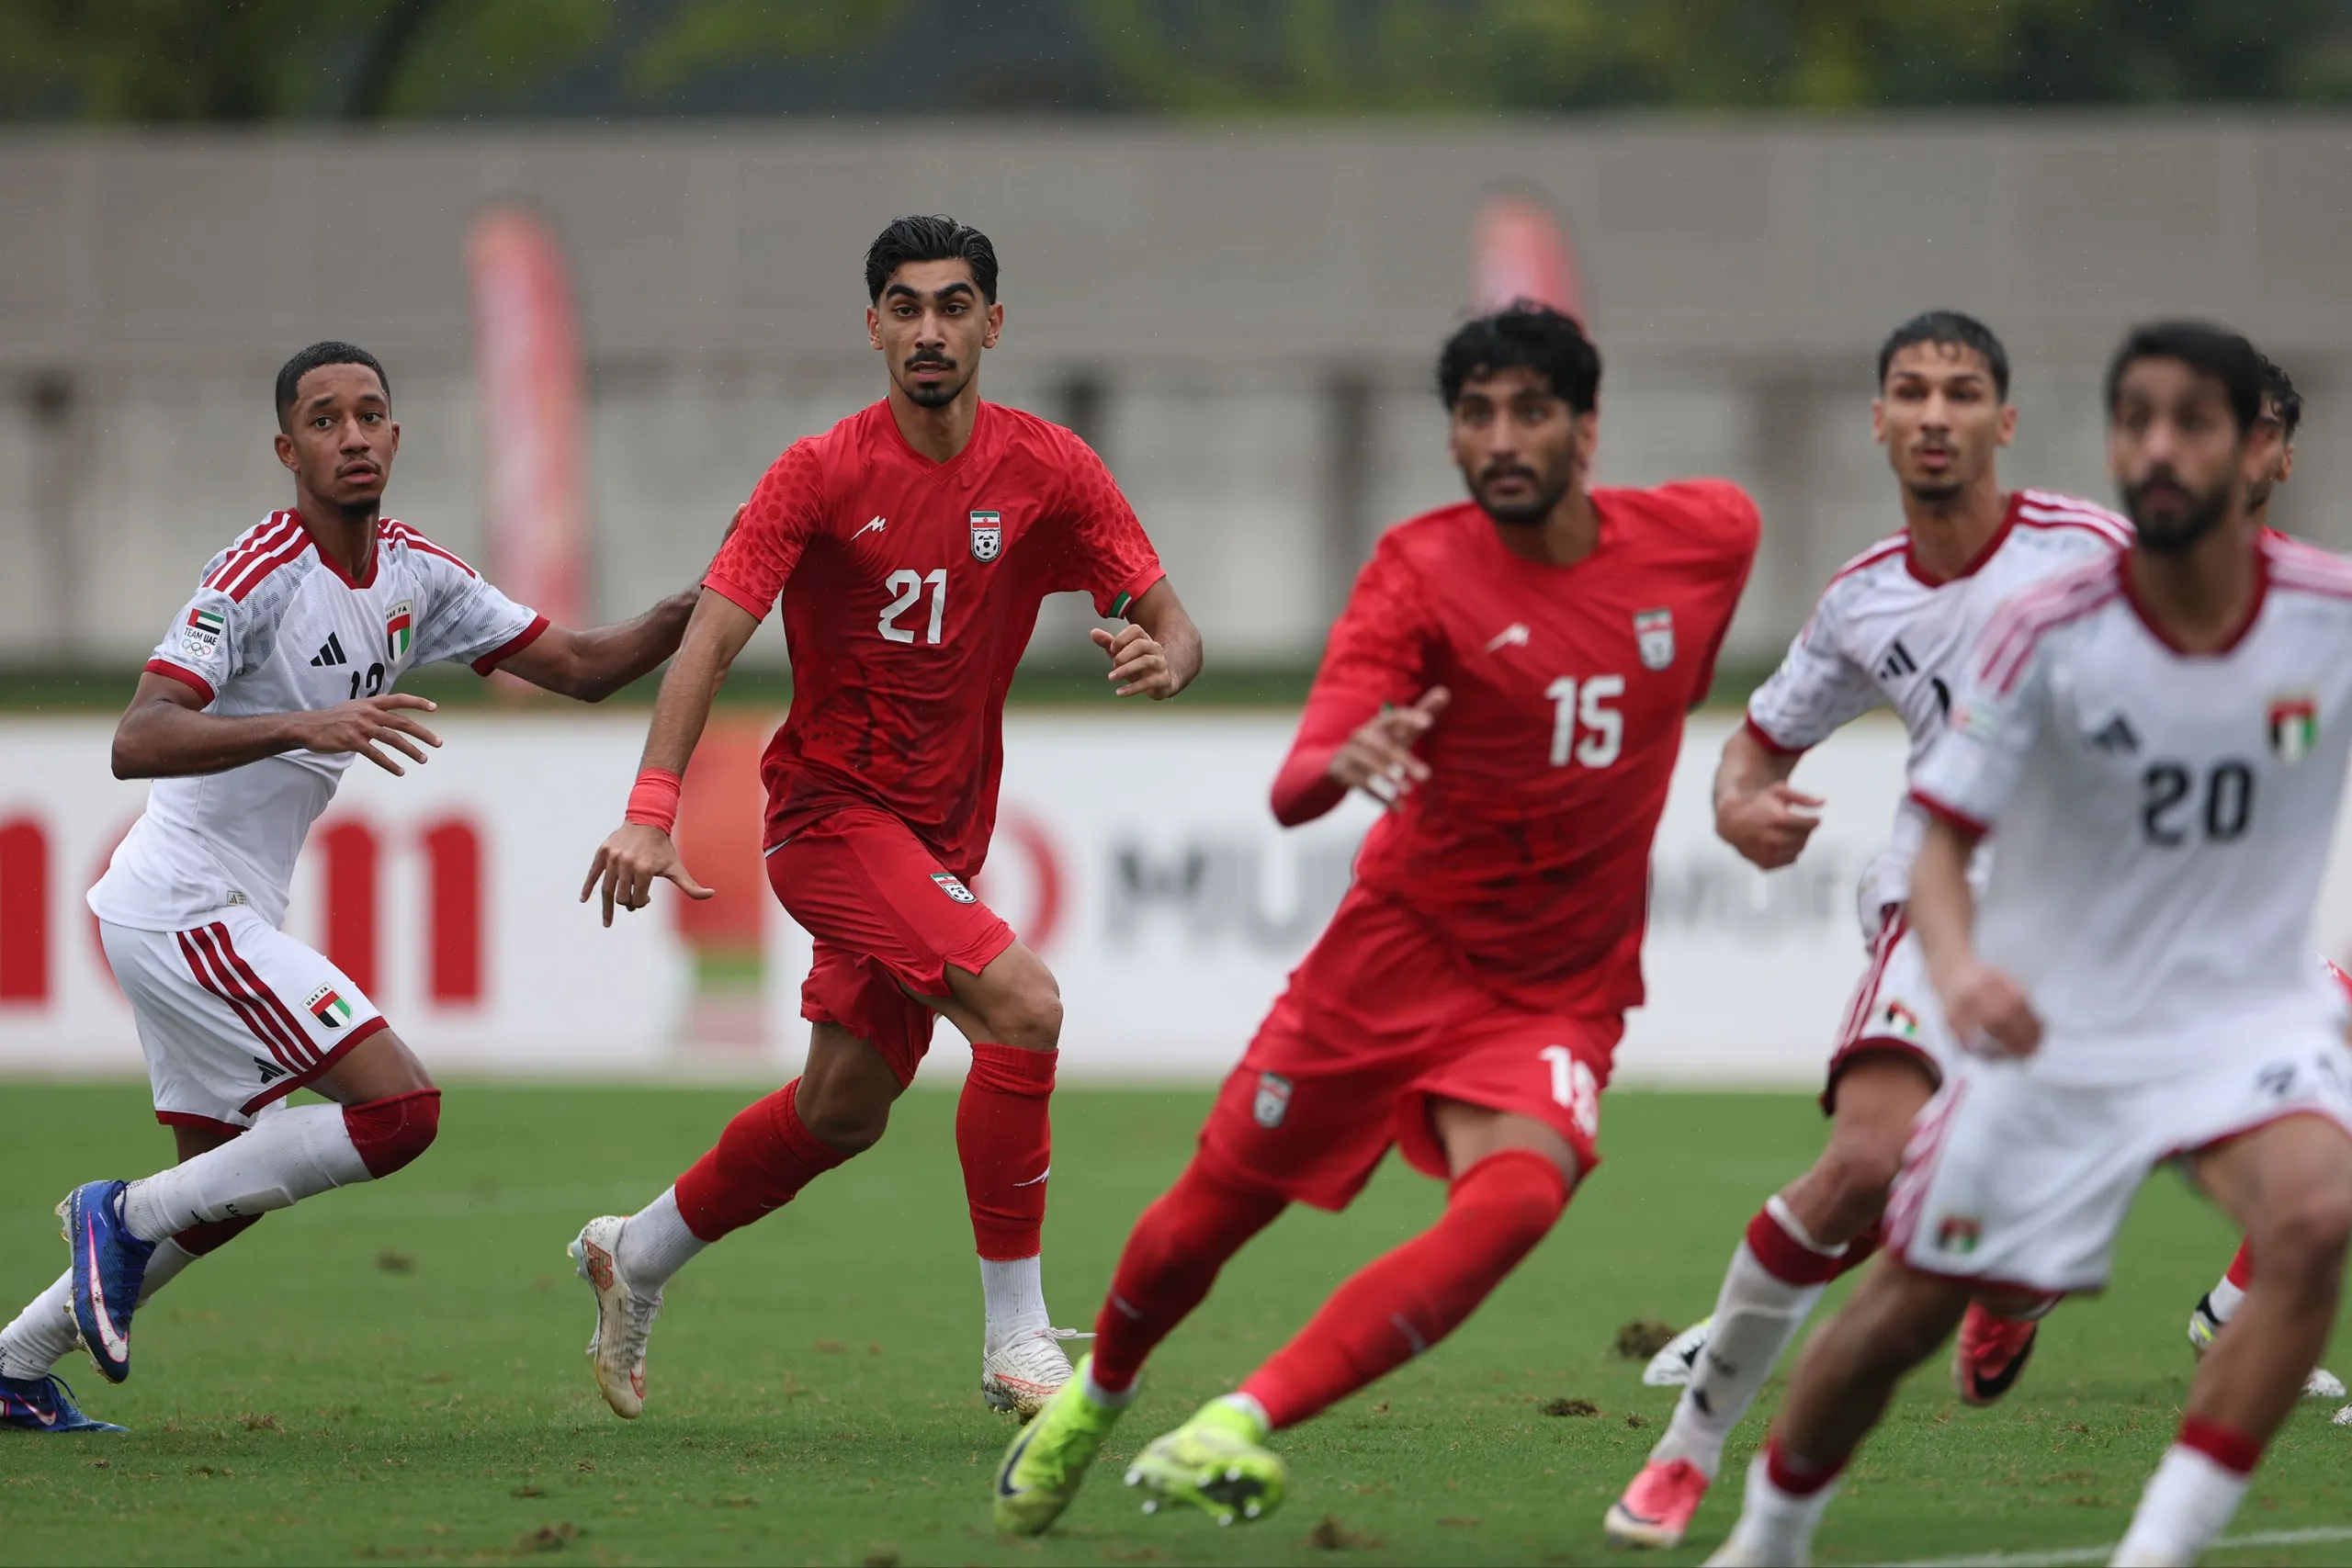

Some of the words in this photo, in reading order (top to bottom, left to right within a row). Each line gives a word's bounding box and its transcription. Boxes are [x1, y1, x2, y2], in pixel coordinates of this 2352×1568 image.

[184, 627, 203, 640] TEAM
[203, 634, 218, 646] UAE
[877, 569, 947, 644] 21
[1544, 675, 1625, 768] 15
[2141, 757, 2256, 847] 20
[306, 993, 319, 1006] UAE
